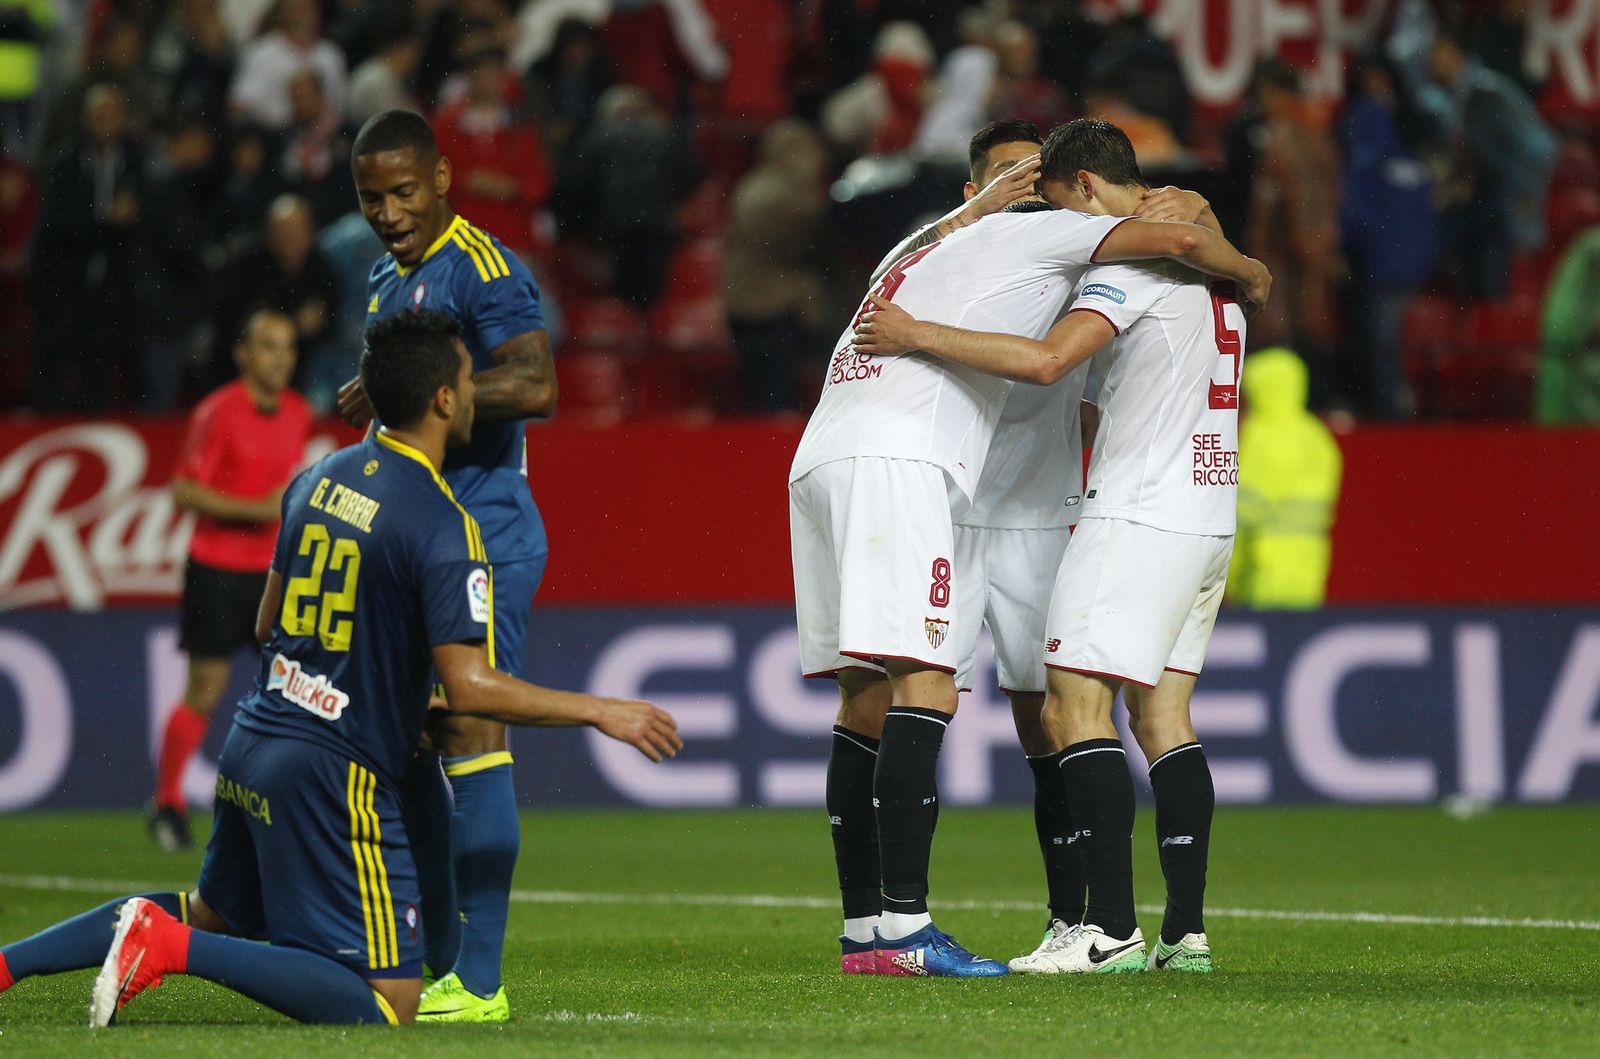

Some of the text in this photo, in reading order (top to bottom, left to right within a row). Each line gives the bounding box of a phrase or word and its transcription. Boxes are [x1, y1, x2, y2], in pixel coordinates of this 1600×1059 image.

[1192, 433, 1222, 450] SEE
[280, 523, 362, 652] 22
[929, 557, 951, 608] 8
[216, 773, 273, 826] BANCA
